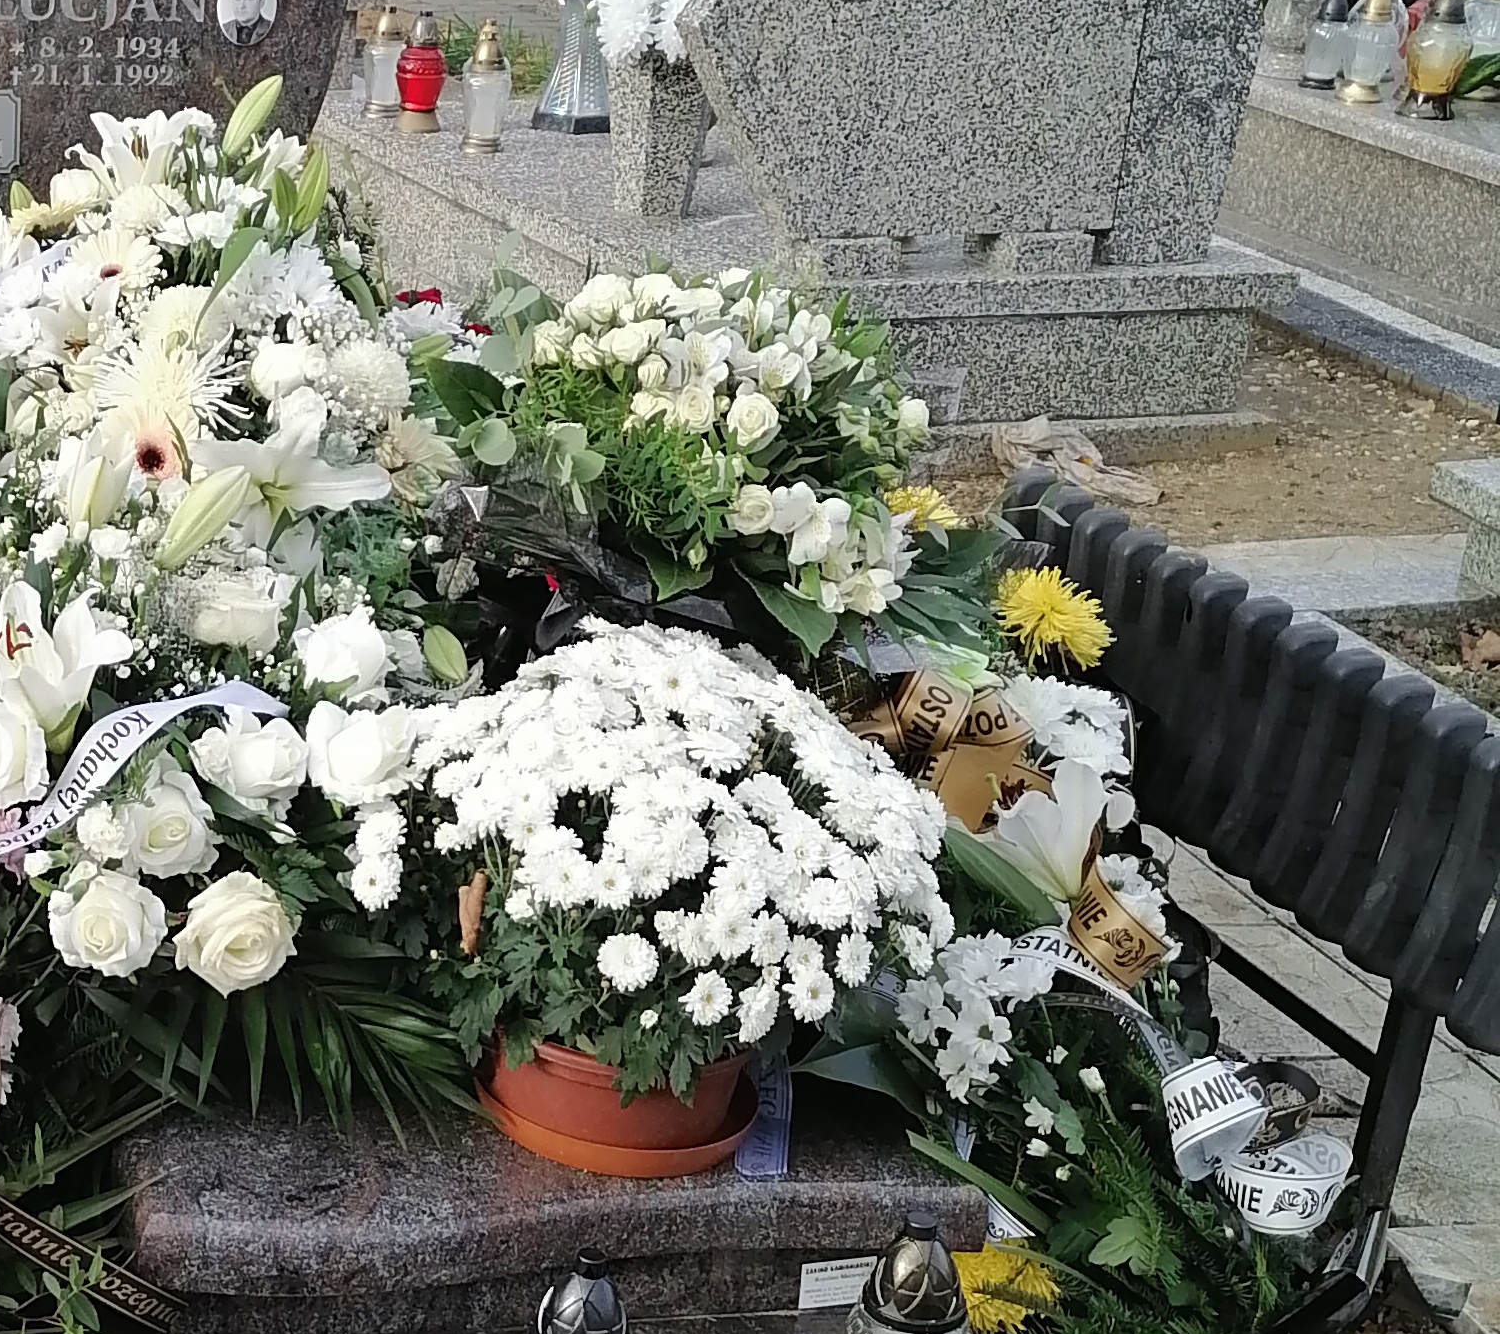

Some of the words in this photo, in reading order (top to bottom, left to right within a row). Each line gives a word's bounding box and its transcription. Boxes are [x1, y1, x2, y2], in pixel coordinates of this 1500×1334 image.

[114, 36, 181, 59] 1934
[114, 64, 175, 87] 1992
[58, 709, 155, 815] Kochanej
